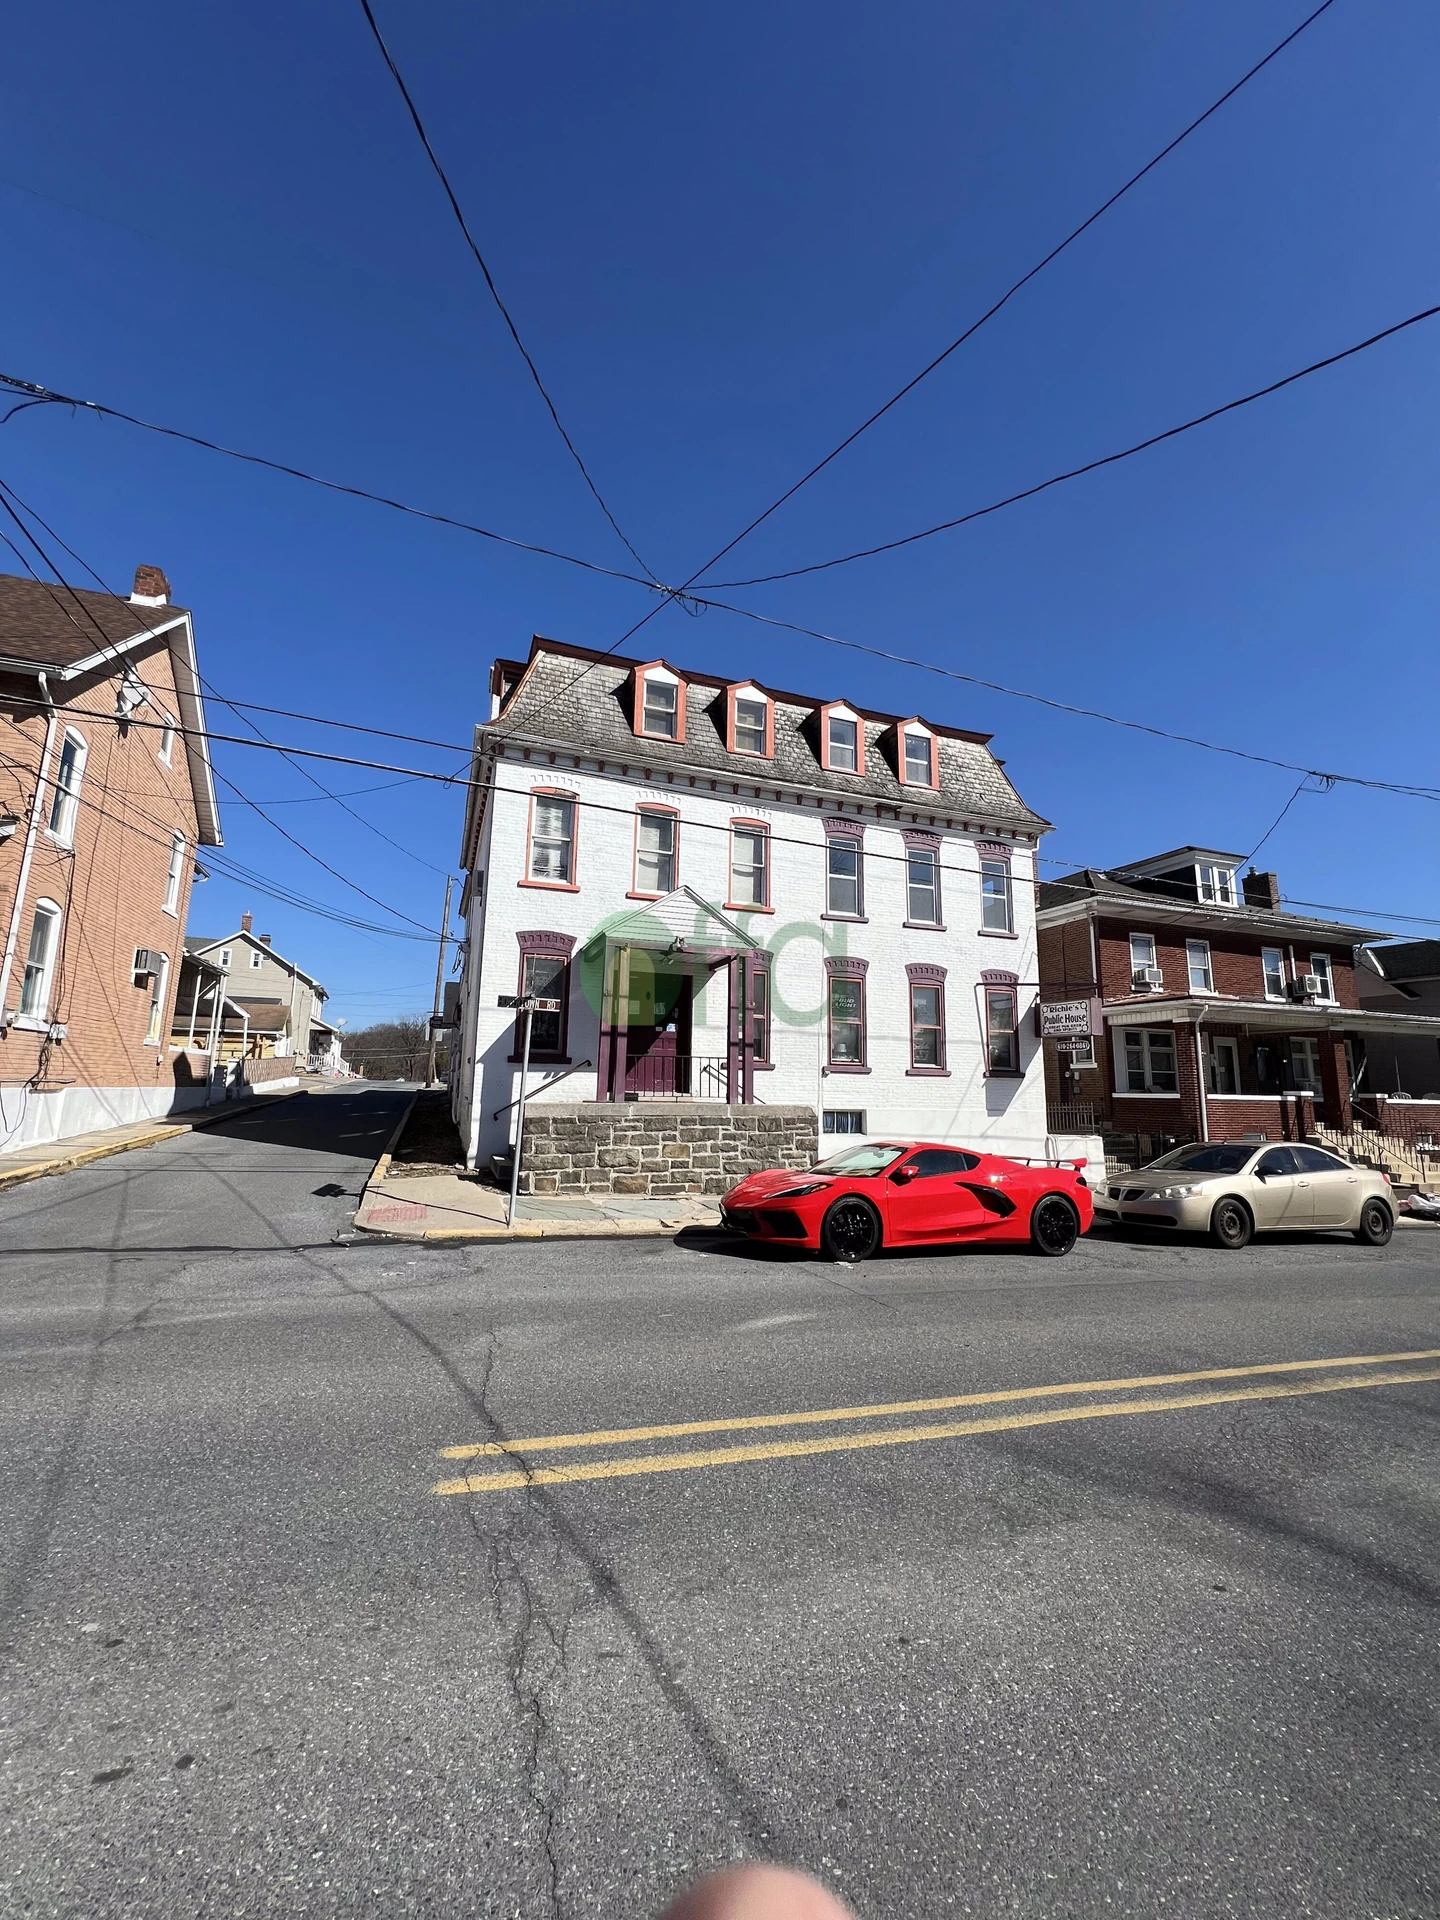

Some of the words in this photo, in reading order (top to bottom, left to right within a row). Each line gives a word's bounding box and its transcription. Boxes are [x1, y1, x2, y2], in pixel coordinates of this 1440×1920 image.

[546, 1000, 557, 1010] RD
[1049, 1004, 1079, 1013] Richie's
[1044, 1014, 1065, 1025] Public
[1065, 1014, 1087, 1023] House
